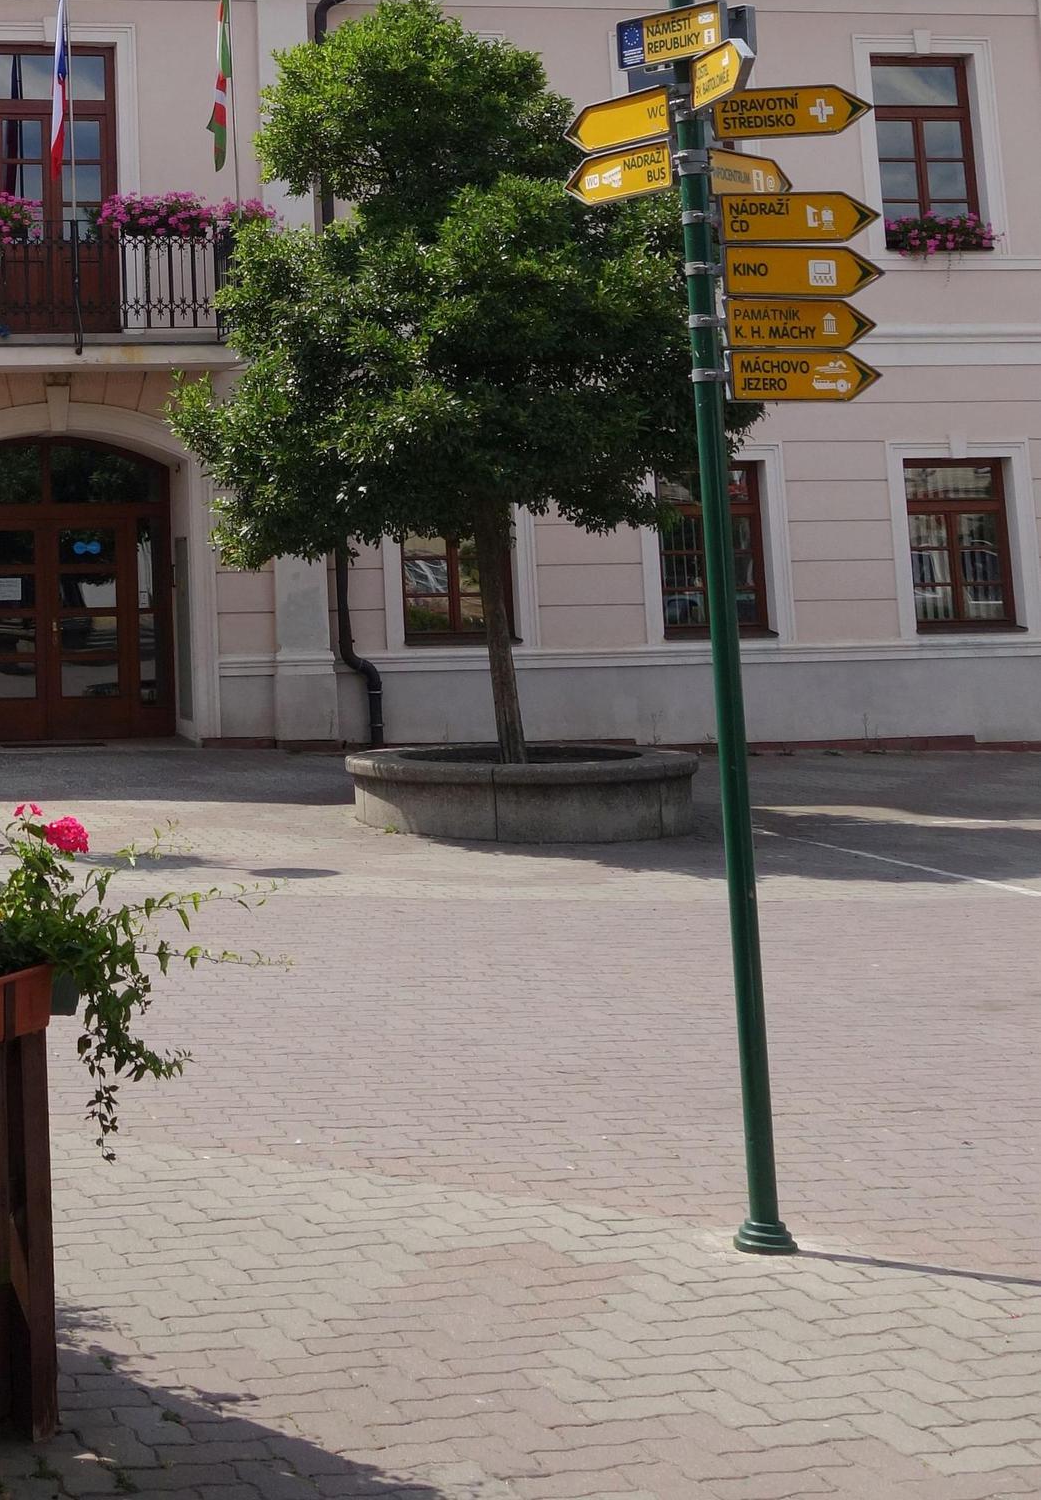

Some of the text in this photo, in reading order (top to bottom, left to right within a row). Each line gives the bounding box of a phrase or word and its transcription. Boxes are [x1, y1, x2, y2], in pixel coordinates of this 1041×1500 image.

[646, 12, 692, 38] NÁMĚSTÍ
[647, 32, 700, 55] REPUBLIKY
[647, 104, 666, 119] WC
[721, 93, 799, 113] ZDRAVOTNÍ
[723, 113, 796, 130] STŘEDISKO
[623, 146, 666, 171] NÁDRAŽÍ
[647, 167, 666, 183] BUS
[729, 199, 790, 216] NÁDRAŽÍ
[730, 216, 750, 233] ČD
[733, 263, 768, 277] KINO
[733, 306, 801, 321] PAMÁTNÍK
[735, 322, 816, 339] K. H. MÁCHY
[740, 357, 810, 374] MÁCHOVO
[741, 378, 788, 392] JEZERO
